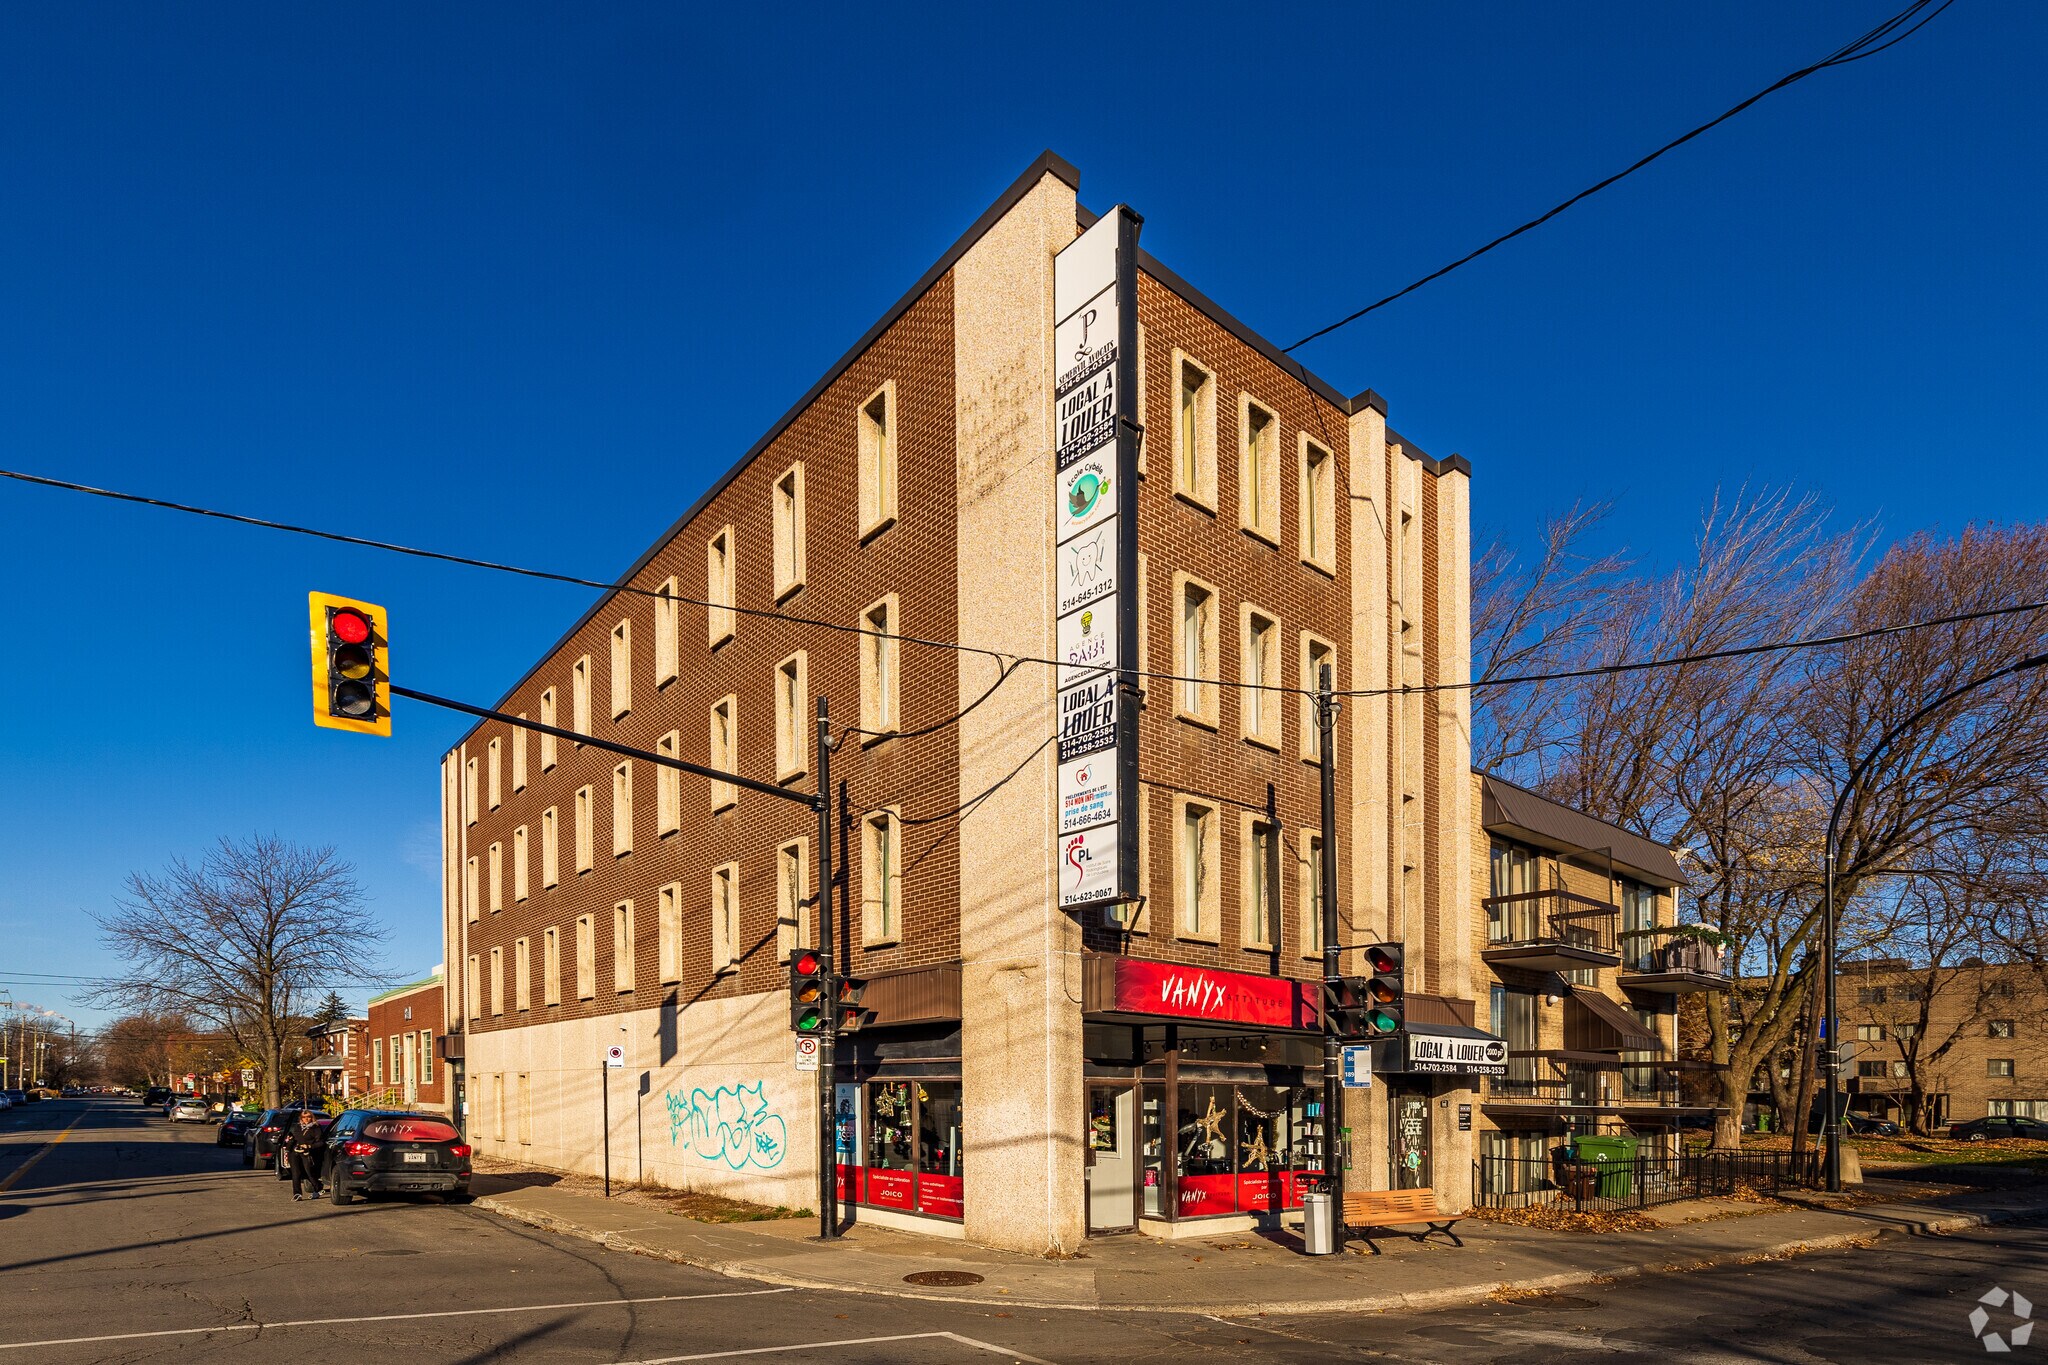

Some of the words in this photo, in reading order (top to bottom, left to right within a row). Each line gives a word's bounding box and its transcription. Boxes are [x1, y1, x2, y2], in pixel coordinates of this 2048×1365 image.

[1088, 340, 1114, 364] AVOCATS
[1060, 352, 1112, 393] 514-645-0333
[1062, 381, 1099, 421] LOCAL
[1104, 369, 1112, 393] À
[1062, 393, 1112, 446] LOUER
[1060, 418, 1114, 458] 514-702-2584
[1060, 428, 1113, 467] 514-258-2535
[1062, 579, 1112, 610] 514-645-1312
[1070, 632, 1104, 652] AGENCE
[1064, 684, 1100, 713] LOCAL
[1105, 675, 1113, 698] À
[1064, 700, 1113, 739] LOUER
[1062, 725, 1114, 750] 514-702-2584
[1062, 735, 1114, 760] 514-258-2535
[1065, 800, 1073, 808] 514
[1074, 796, 1084, 805] MON
[1065, 807, 1079, 818] prise
[1081, 804, 1088, 812] de
[1090, 801, 1104, 811] sang
[1064, 808, 1110, 829] 514-666-4634
[1065, 888, 1112, 904] 514-623-0067
[1162, 973, 1226, 1015] VANYX
[1227, 994, 1283, 1007] ATTITUDE
[1414, 1041, 1443, 1059] LOCAL
[1447, 1040, 1454, 1060] À
[1457, 1044, 1484, 1061] LOUER
[1414, 1063, 1457, 1072] 514-702-2584
[1466, 1065, 1505, 1074] 514-258-2535
[375, 1124, 413, 1134] VANYX
[1182, 1188, 1206, 1204] VANYX
